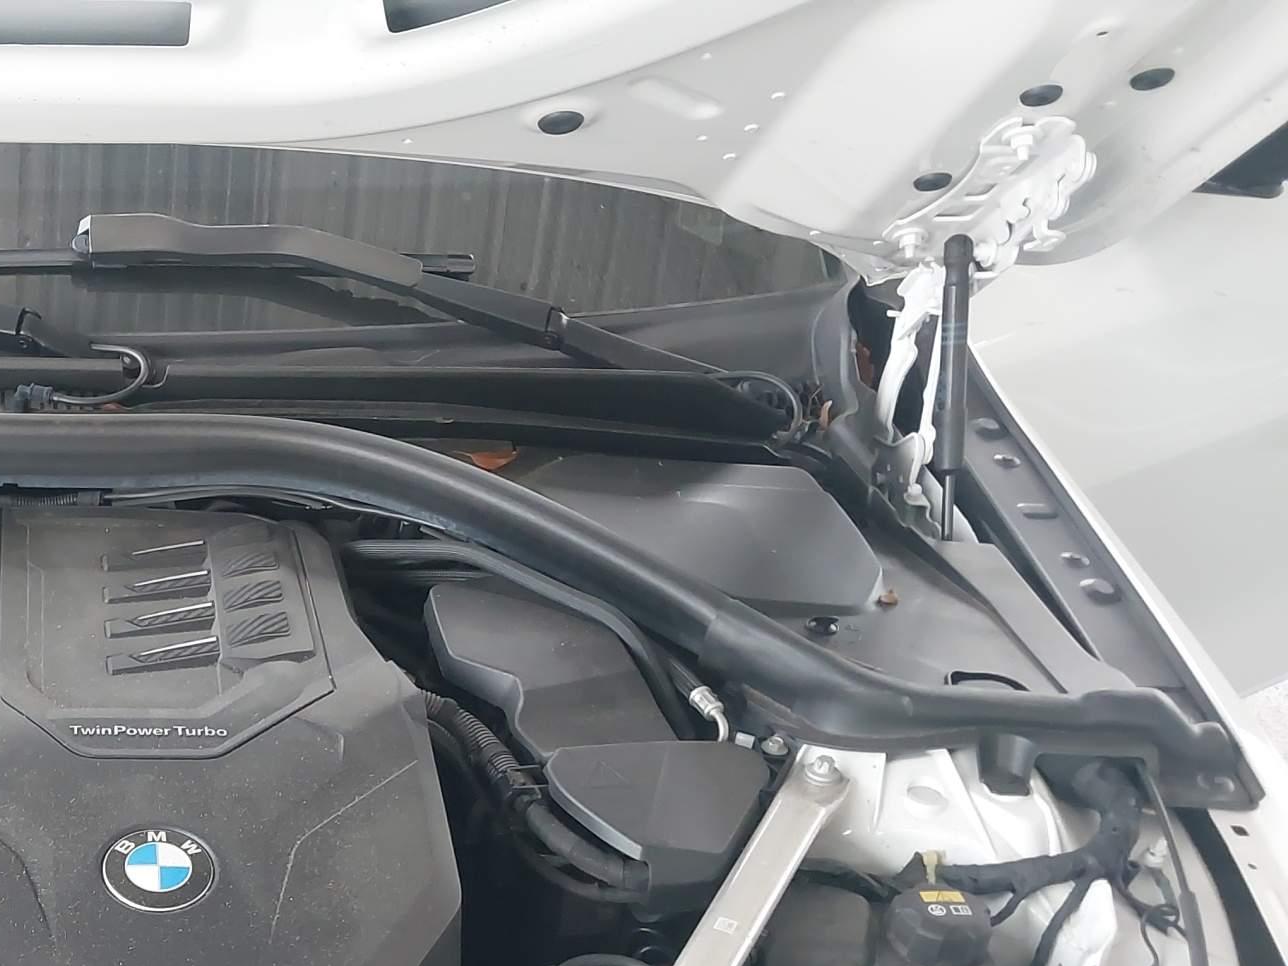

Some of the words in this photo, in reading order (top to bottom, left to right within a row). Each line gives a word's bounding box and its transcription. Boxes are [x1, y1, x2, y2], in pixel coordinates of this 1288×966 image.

[69, 725, 171, 737] TwinPower
[172, 725, 228, 738] Turbo
[114, 831, 202, 855] BMW
